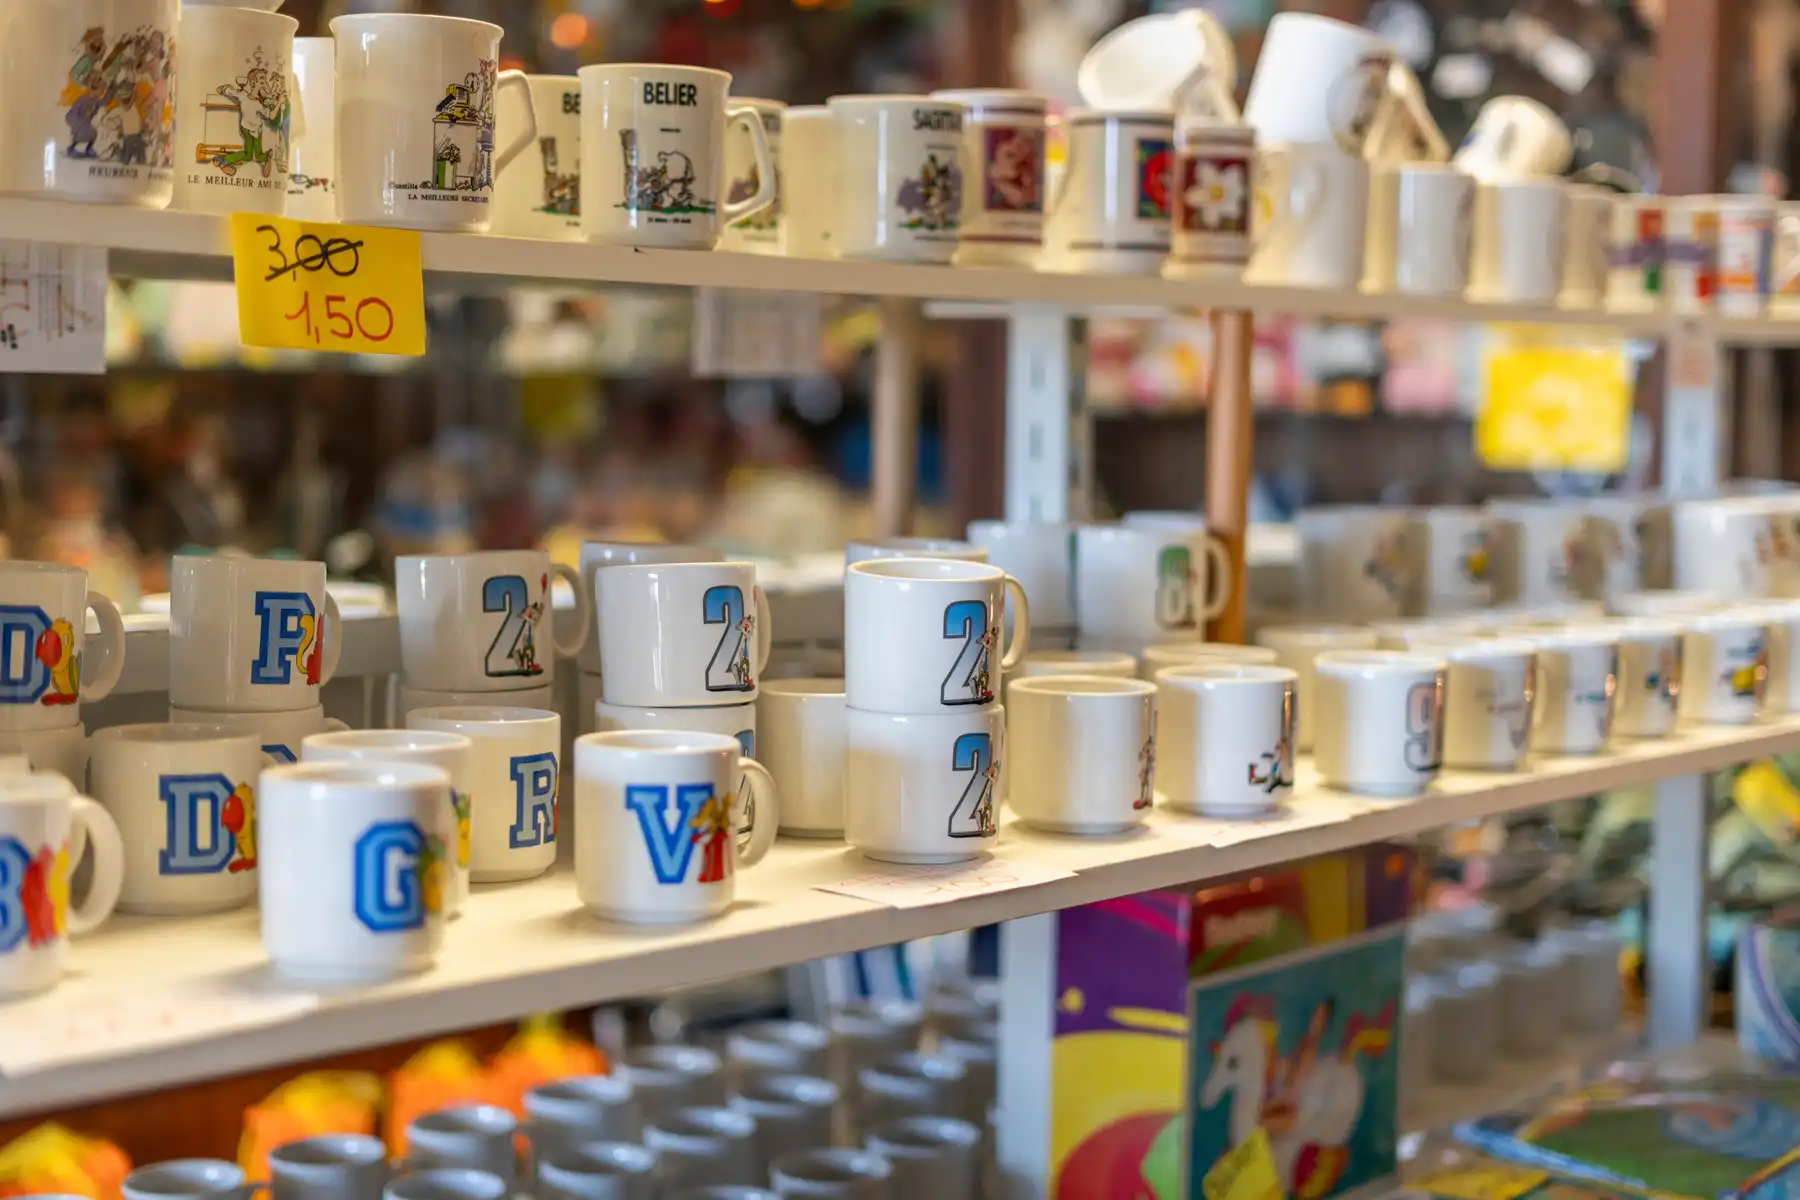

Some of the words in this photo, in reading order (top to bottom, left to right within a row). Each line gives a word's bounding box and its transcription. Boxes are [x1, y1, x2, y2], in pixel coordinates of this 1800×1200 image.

[643, 82, 698, 106] BELIER
[187, 174, 201, 184] LE
[205, 175, 254, 188] MEILLEUR
[257, 180, 272, 189] AMI
[408, 193, 418, 201] LA
[284, 290, 394, 345] 1,50
[482, 575, 543, 678] 2
[702, 585, 756, 693] 2
[940, 600, 995, 706] 2
[159, 773, 238, 876] D
[509, 751, 558, 849] R
[625, 783, 716, 884] V
[947, 732, 997, 839] 2
[353, 820, 430, 934] G
